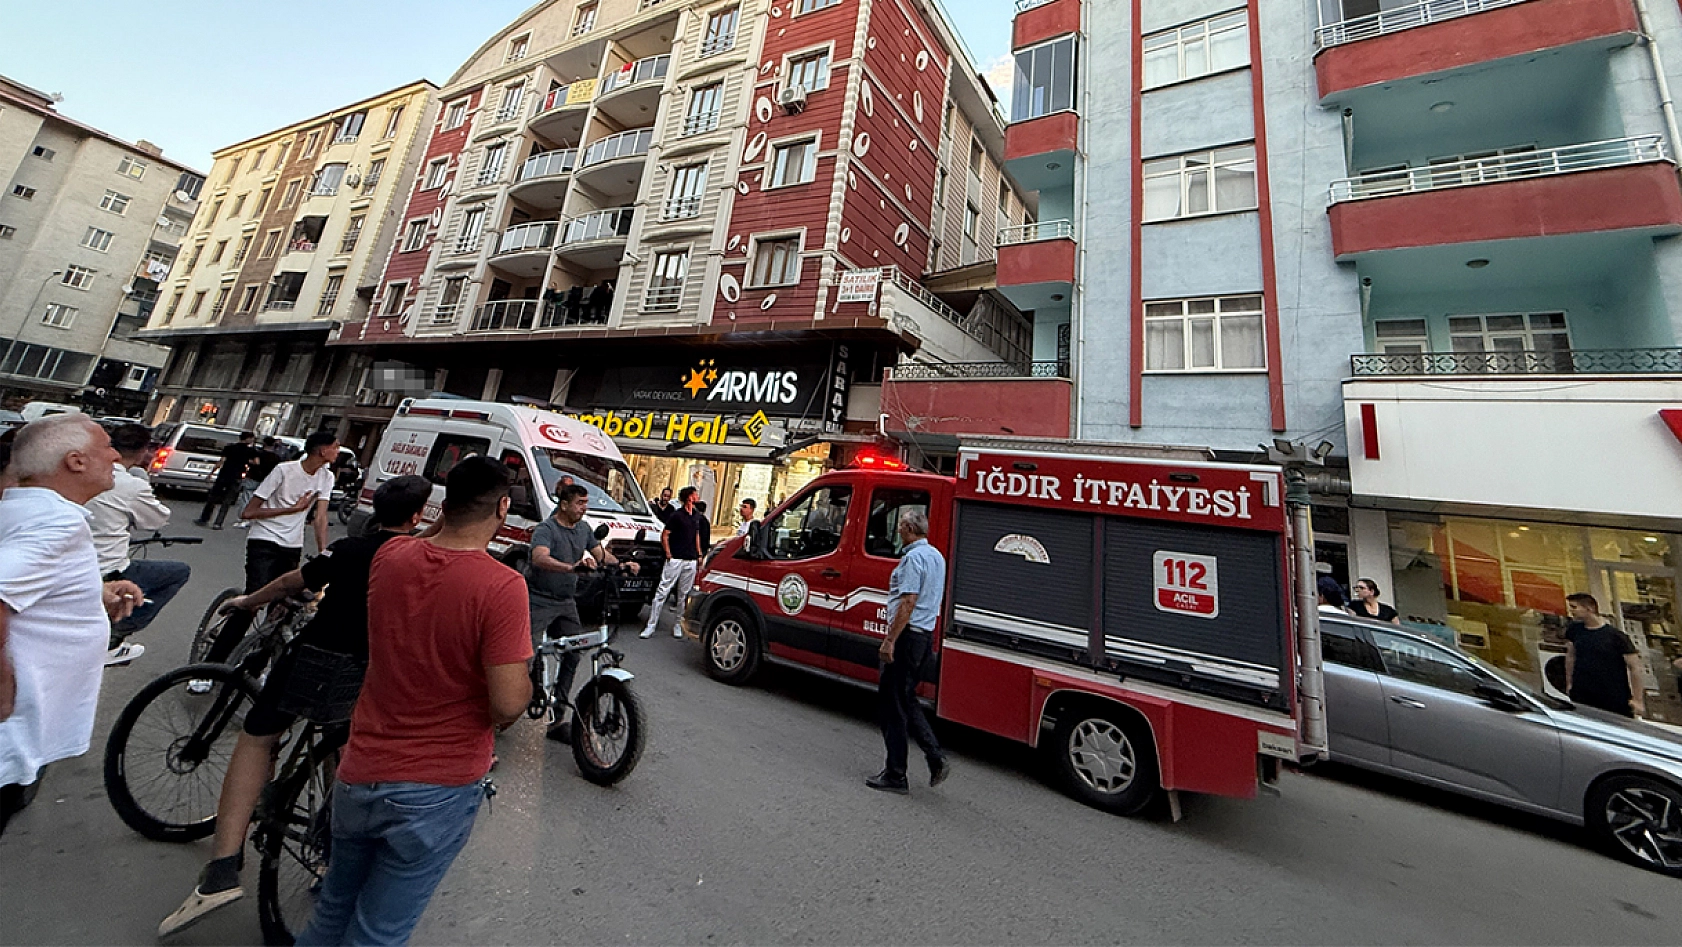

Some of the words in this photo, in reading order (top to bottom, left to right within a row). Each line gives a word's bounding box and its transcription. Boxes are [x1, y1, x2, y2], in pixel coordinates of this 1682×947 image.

[831, 344, 849, 422] SARAY
[974, 465, 1062, 501] IĞDIR
[1072, 472, 1252, 520] İTFAİYESİ
[1163, 558, 1208, 591] 112
